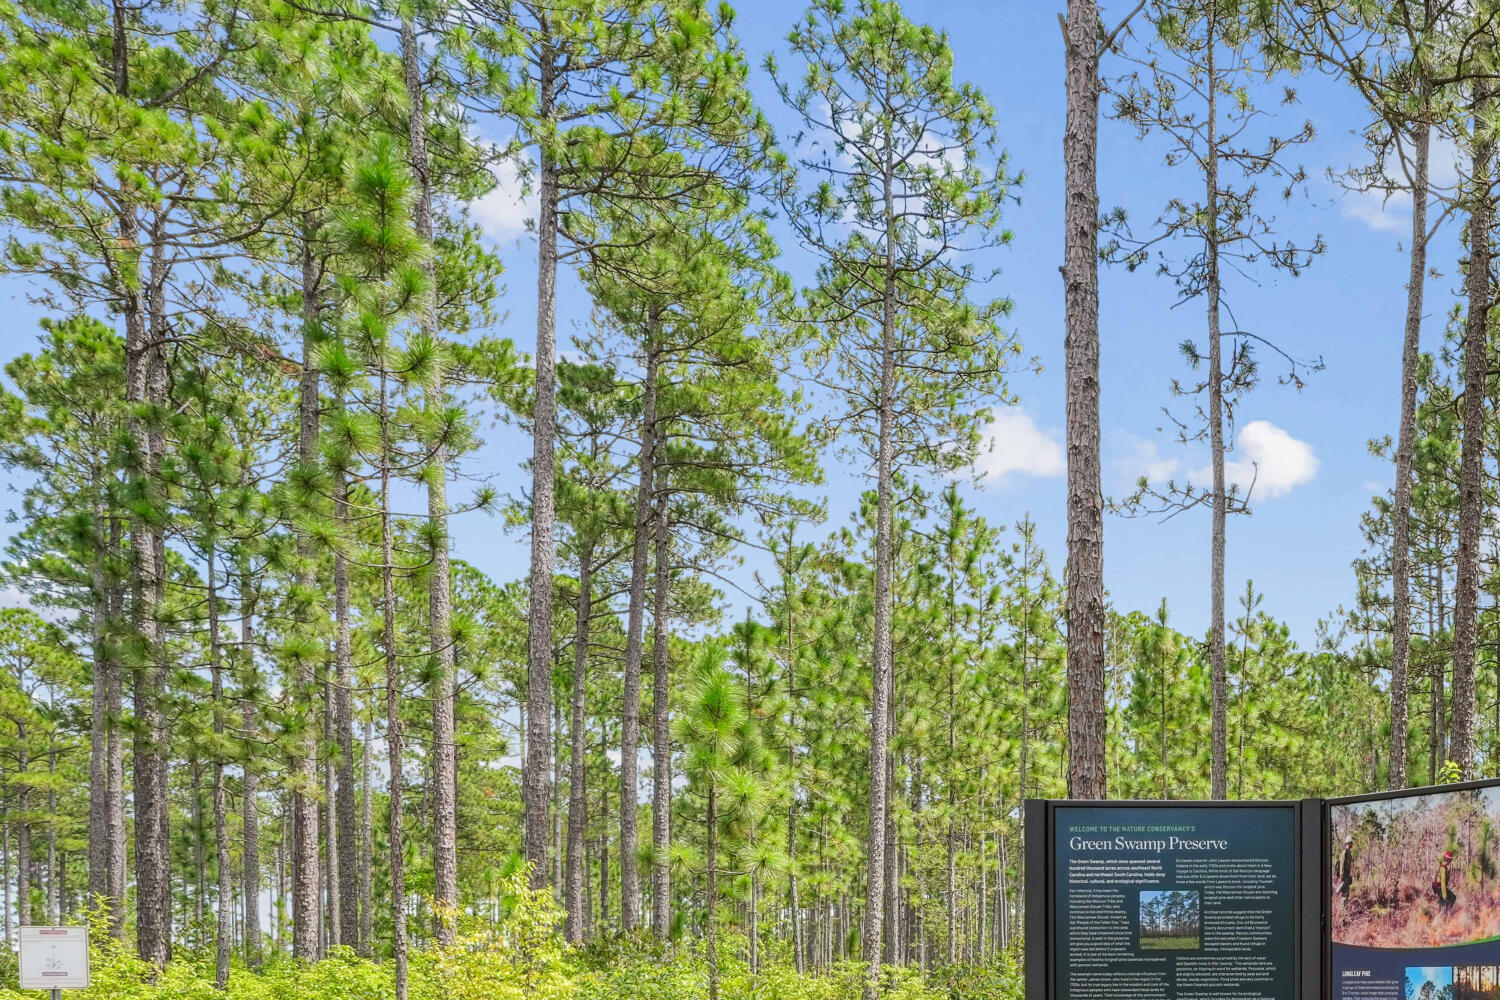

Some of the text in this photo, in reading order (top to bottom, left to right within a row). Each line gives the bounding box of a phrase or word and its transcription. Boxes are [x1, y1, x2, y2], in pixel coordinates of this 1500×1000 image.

[1069, 836, 1227, 852] Green Swamp Preserve
